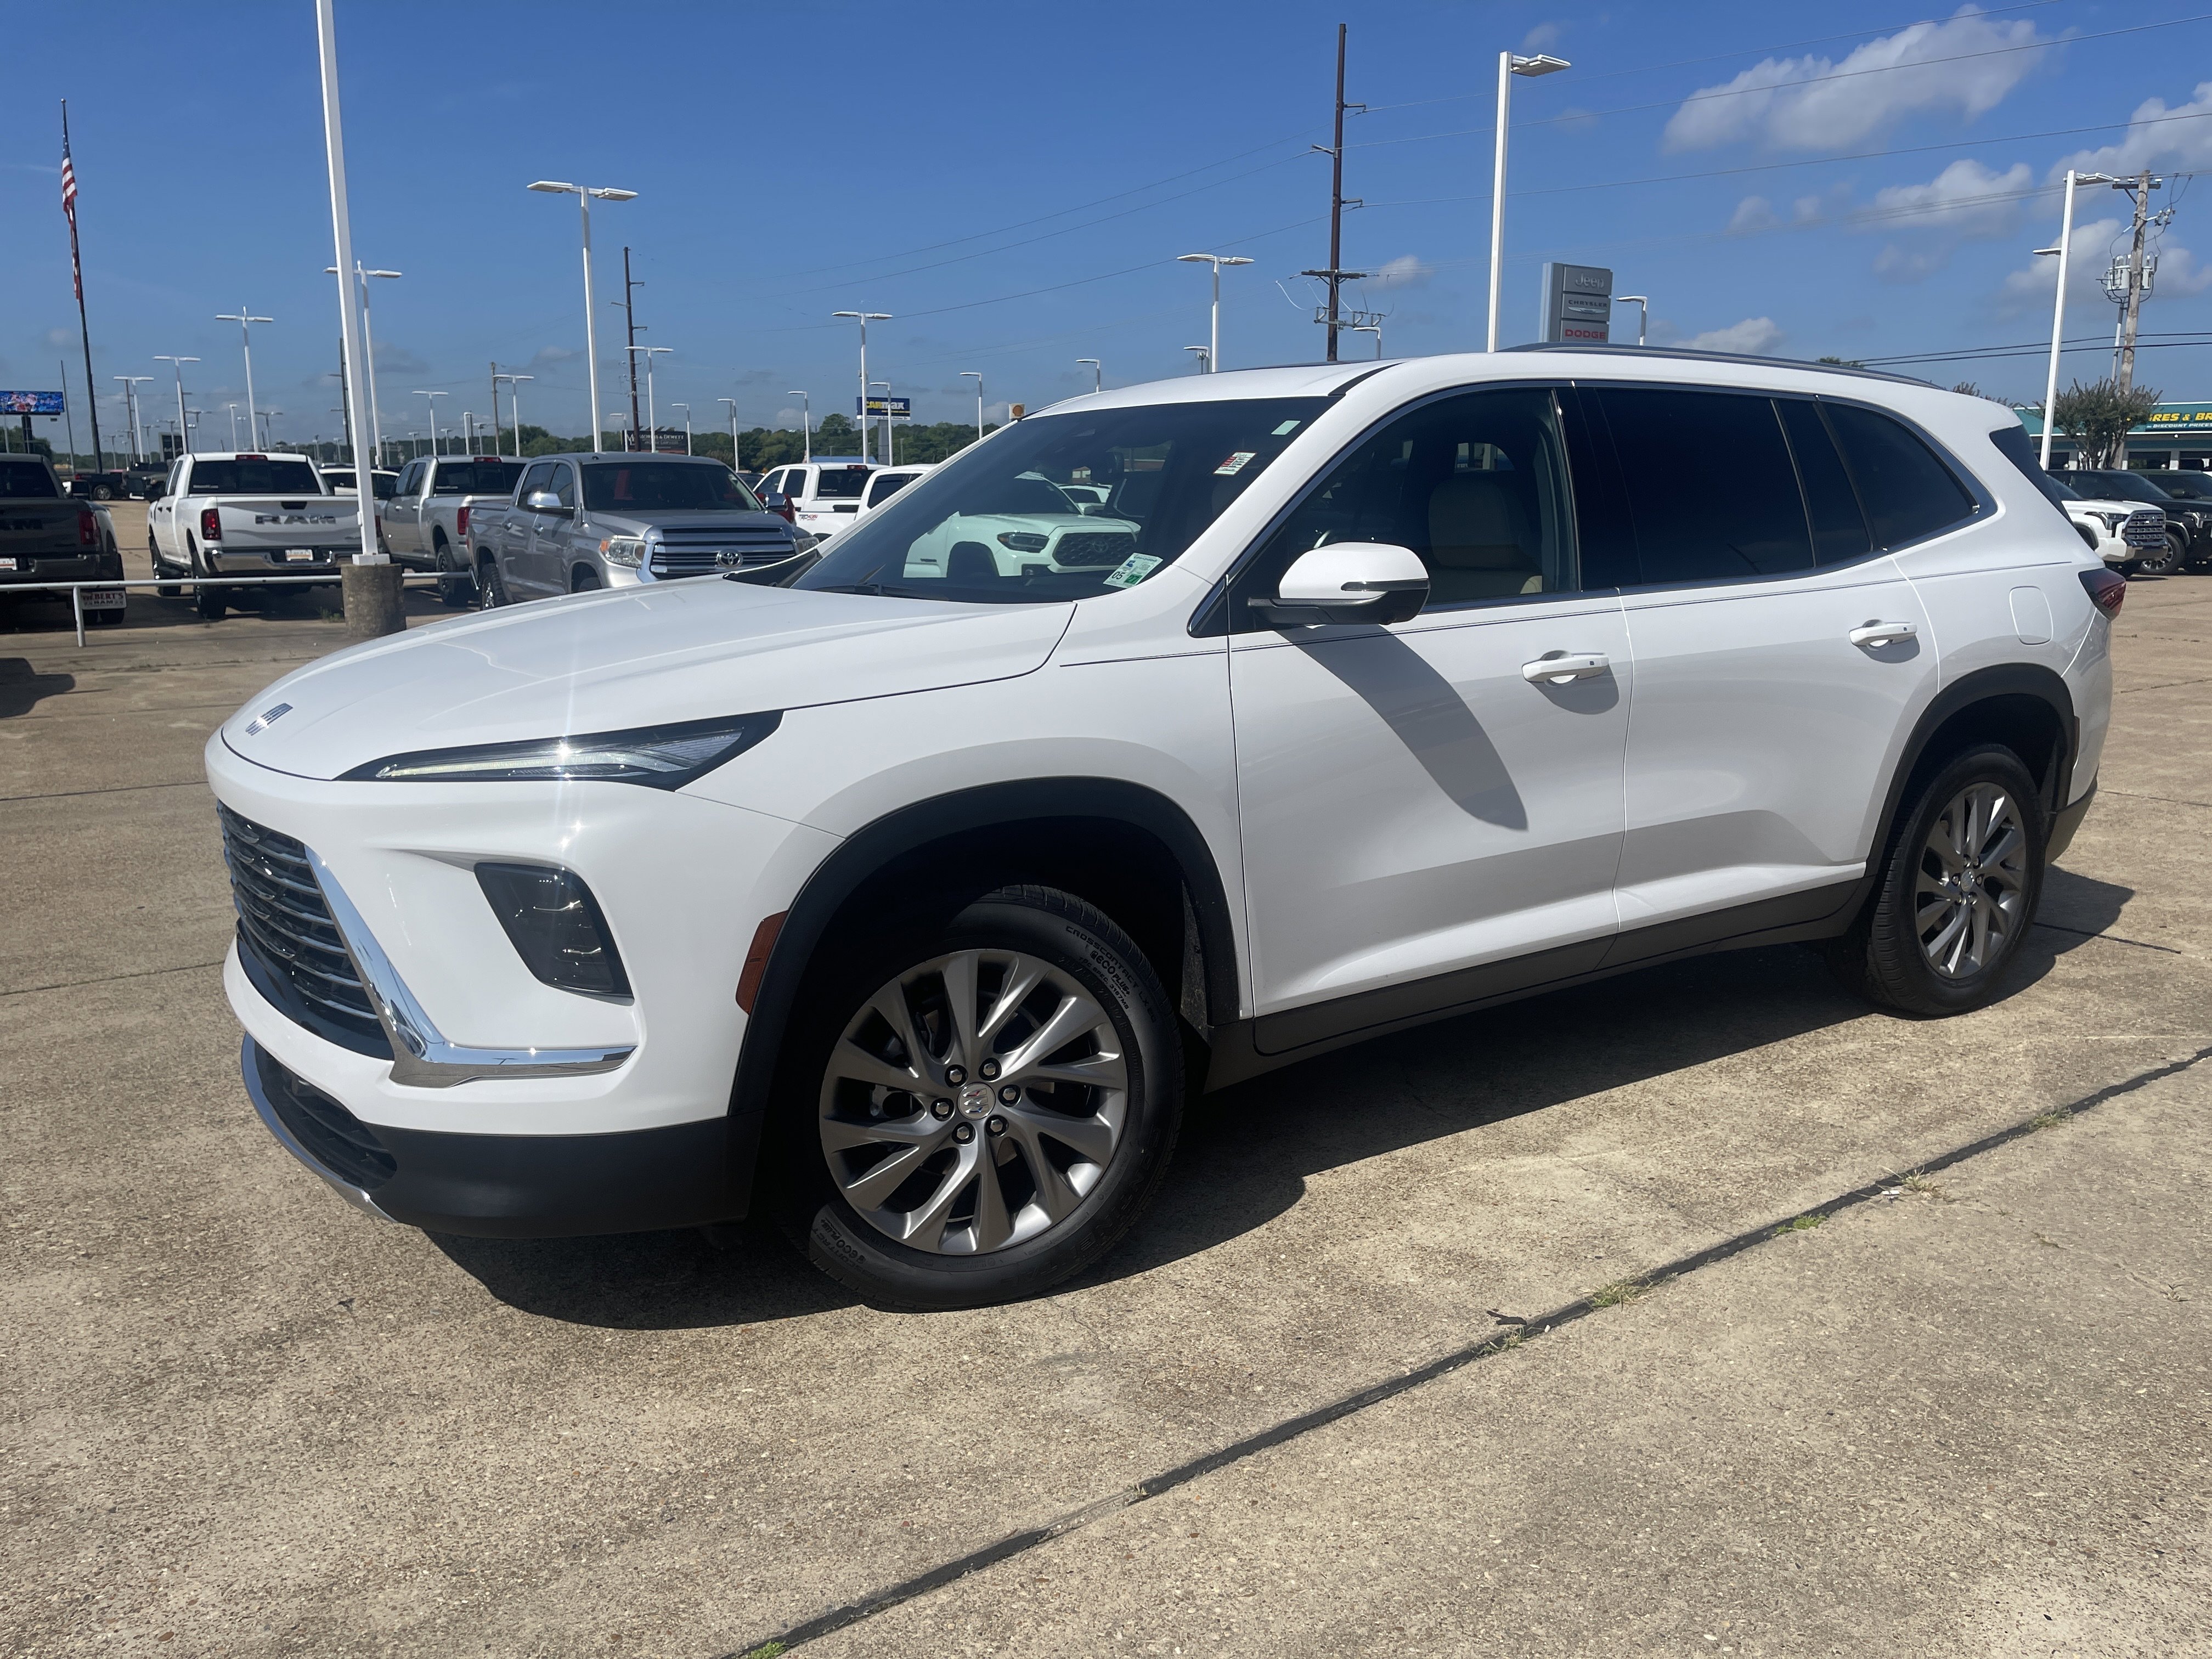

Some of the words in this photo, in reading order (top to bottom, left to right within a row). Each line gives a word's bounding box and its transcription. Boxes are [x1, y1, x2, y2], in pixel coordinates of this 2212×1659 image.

[1575, 273, 1605, 291] Jeep
[1568, 300, 1607, 308] CHRYSLER
[1565, 329, 1606, 340] DODGE
[2182, 413, 2191, 421] &
[255, 515, 337, 524] RAM
[1111, 571, 1125, 580] 05
[1126, 574, 1141, 583] 27
[1065, 926, 1139, 988] CROSSCONTACT
